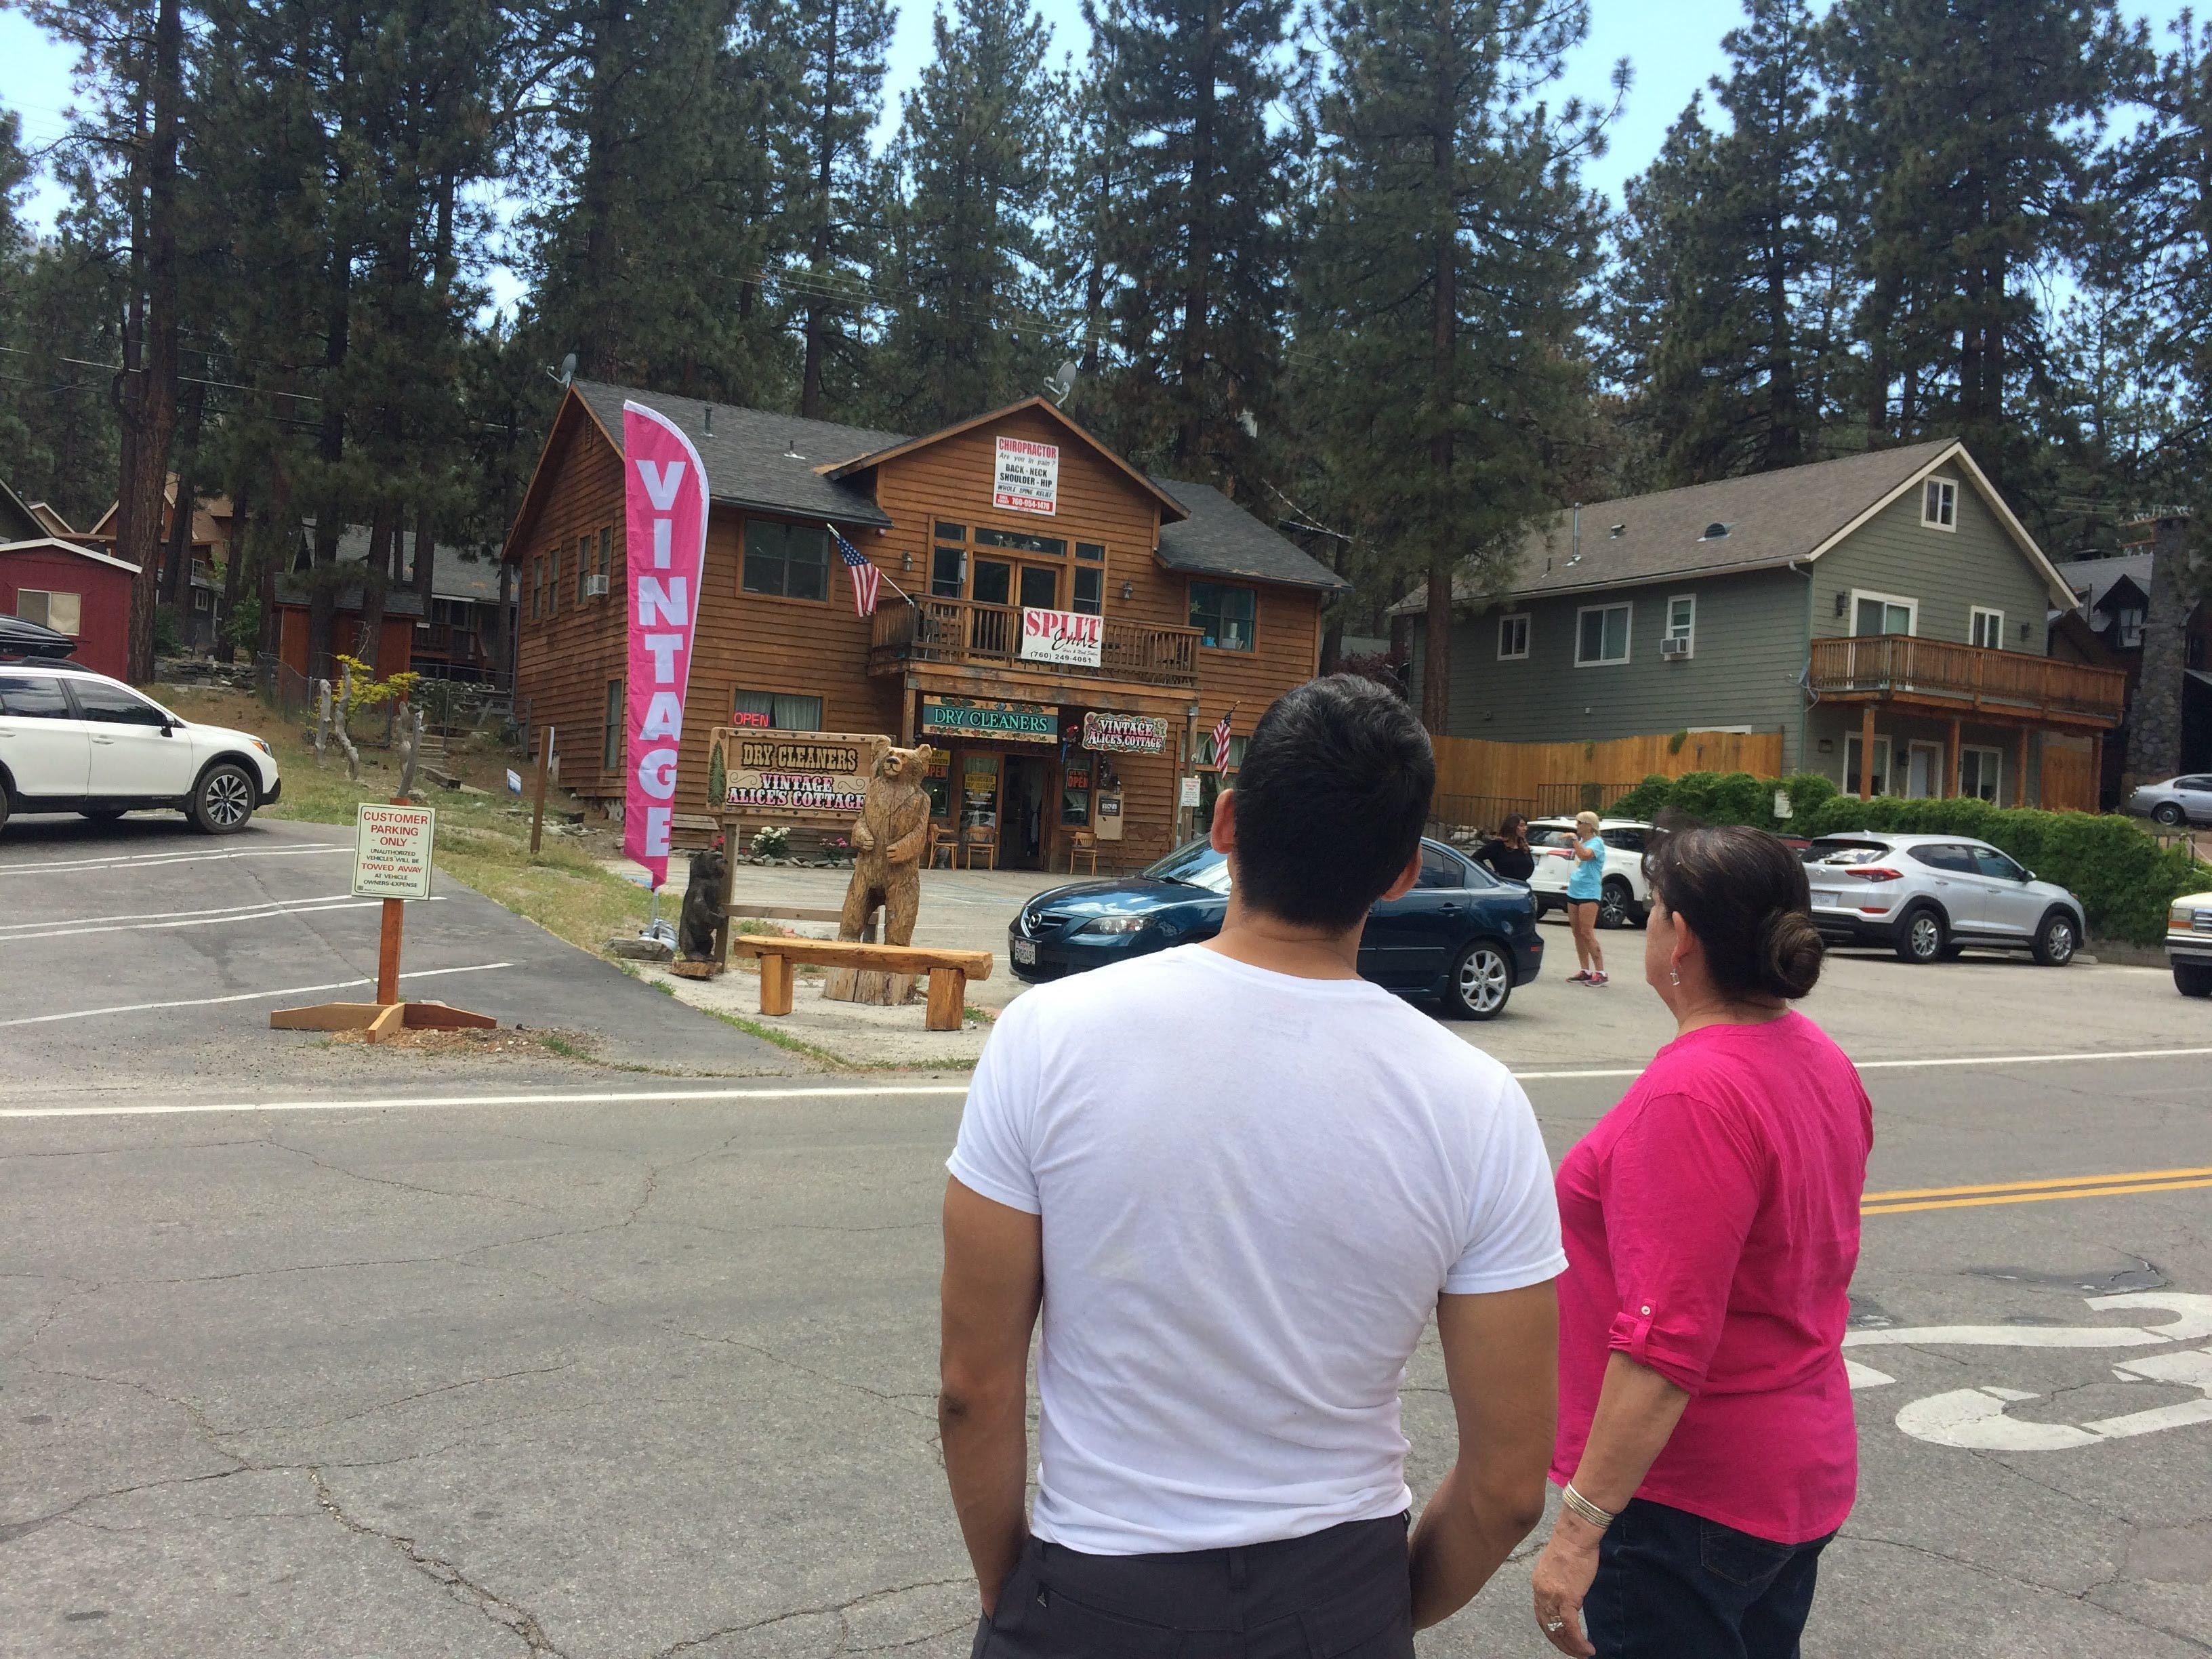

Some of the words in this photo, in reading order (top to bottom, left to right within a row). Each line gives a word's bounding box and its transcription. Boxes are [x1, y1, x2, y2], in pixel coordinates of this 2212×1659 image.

[999, 438, 1057, 459] CHIROPRACTOR
[999, 452, 1010, 460] Are
[1006, 464, 1025, 474] BACK
[1030, 468, 1048, 478] NECK
[1000, 472, 1036, 486] SHOULDER
[1040, 479, 1052, 488] HIP
[998, 485, 1016, 493] WHOLE
[1036, 490, 1054, 498] RELIEF
[1025, 610, 1101, 642] SPLIT
[1051, 627, 1099, 651] Endz
[634, 459, 688, 857] VINTAGE
[1030, 651, 1052, 660] (760)
[734, 712, 770, 727] OPEN
[935, 708, 965, 725] DRY
[969, 711, 1048, 732] CLEANERS
[1099, 718, 1153, 737] VINTAGE
[1124, 735, 1162, 748] COTTAGE
[742, 742, 775, 766] DRY
[777, 744, 858, 773] CLEANERS
[760, 773, 834, 793] VINTAGE
[1067, 775, 1088, 787] OPEN
[728, 787, 787, 806] ALICE'S
[792, 791, 866, 811] COTTAGE
[363, 811, 428, 825] CUSTOMER
[371, 824, 419, 836] PARKING
[380, 836, 408, 846] ONLY
[370, 848, 416, 857] UNAUTHORIZED
[361, 863, 394, 872] TOWED
[397, 865, 423, 874] AWAY
